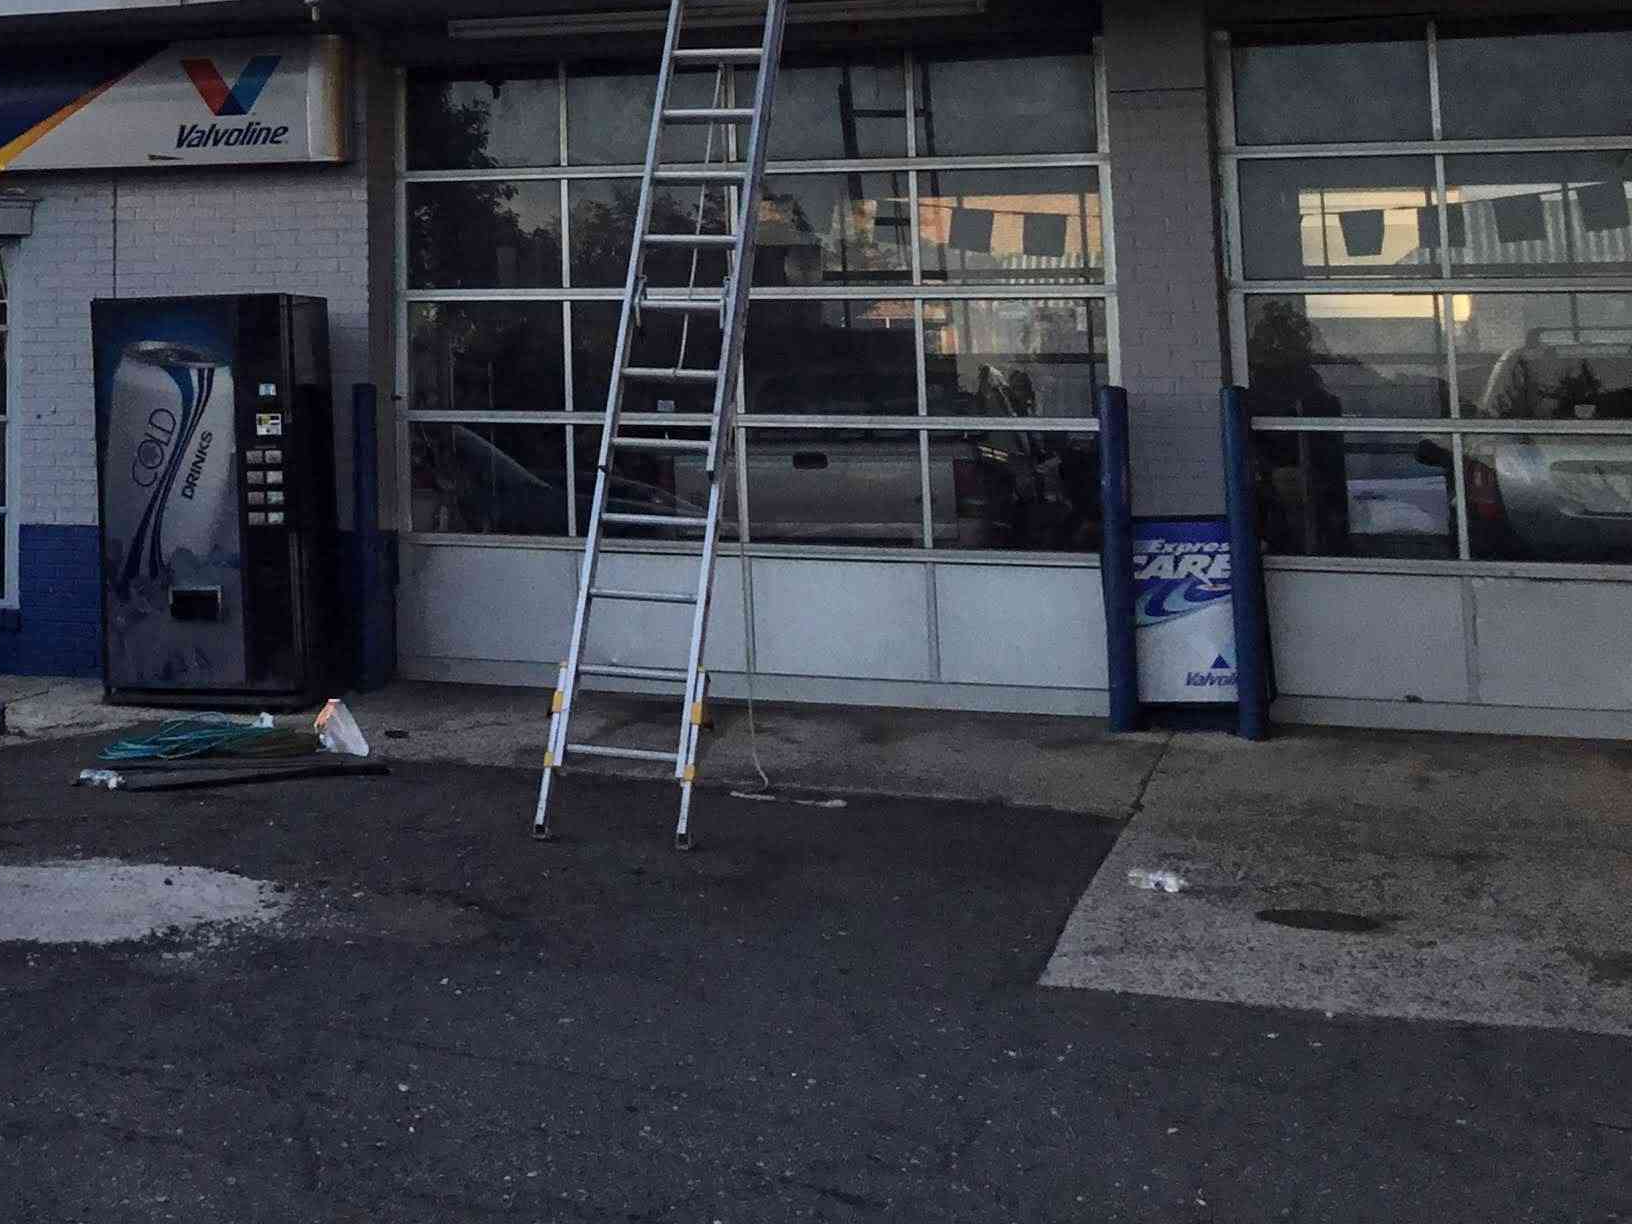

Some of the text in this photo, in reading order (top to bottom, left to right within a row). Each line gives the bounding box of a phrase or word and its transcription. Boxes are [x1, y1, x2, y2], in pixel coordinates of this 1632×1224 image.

[176, 122, 289, 149] Valvoline
[132, 408, 177, 487] COLD
[181, 431, 213, 500] DRINKS
